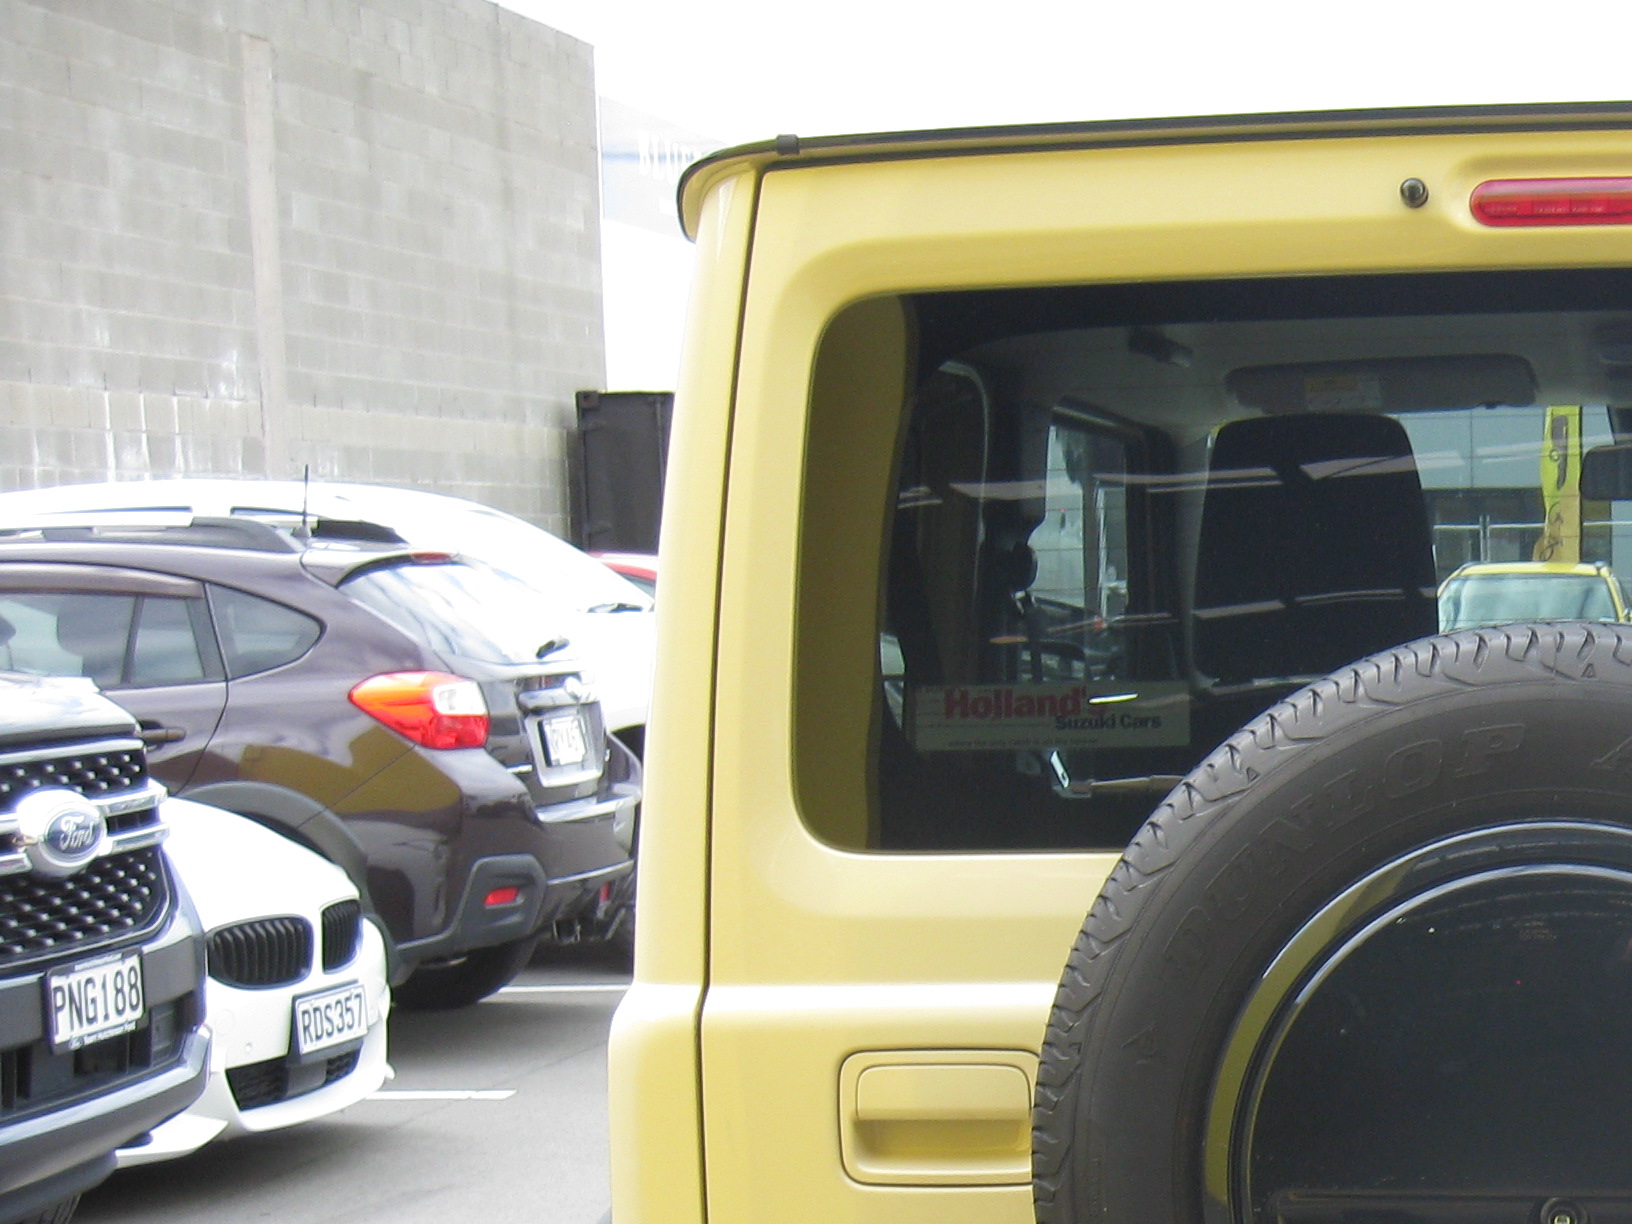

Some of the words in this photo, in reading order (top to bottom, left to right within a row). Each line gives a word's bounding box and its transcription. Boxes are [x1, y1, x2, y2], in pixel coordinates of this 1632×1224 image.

[1055, 713, 1116, 731] Suzuki
[1120, 713, 1162, 730] Cars
[60, 814, 95, 850] Ford
[1160, 722, 1526, 986] DUNLOP
[52, 965, 141, 1037] PNG188
[301, 992, 363, 1045] RDS357
